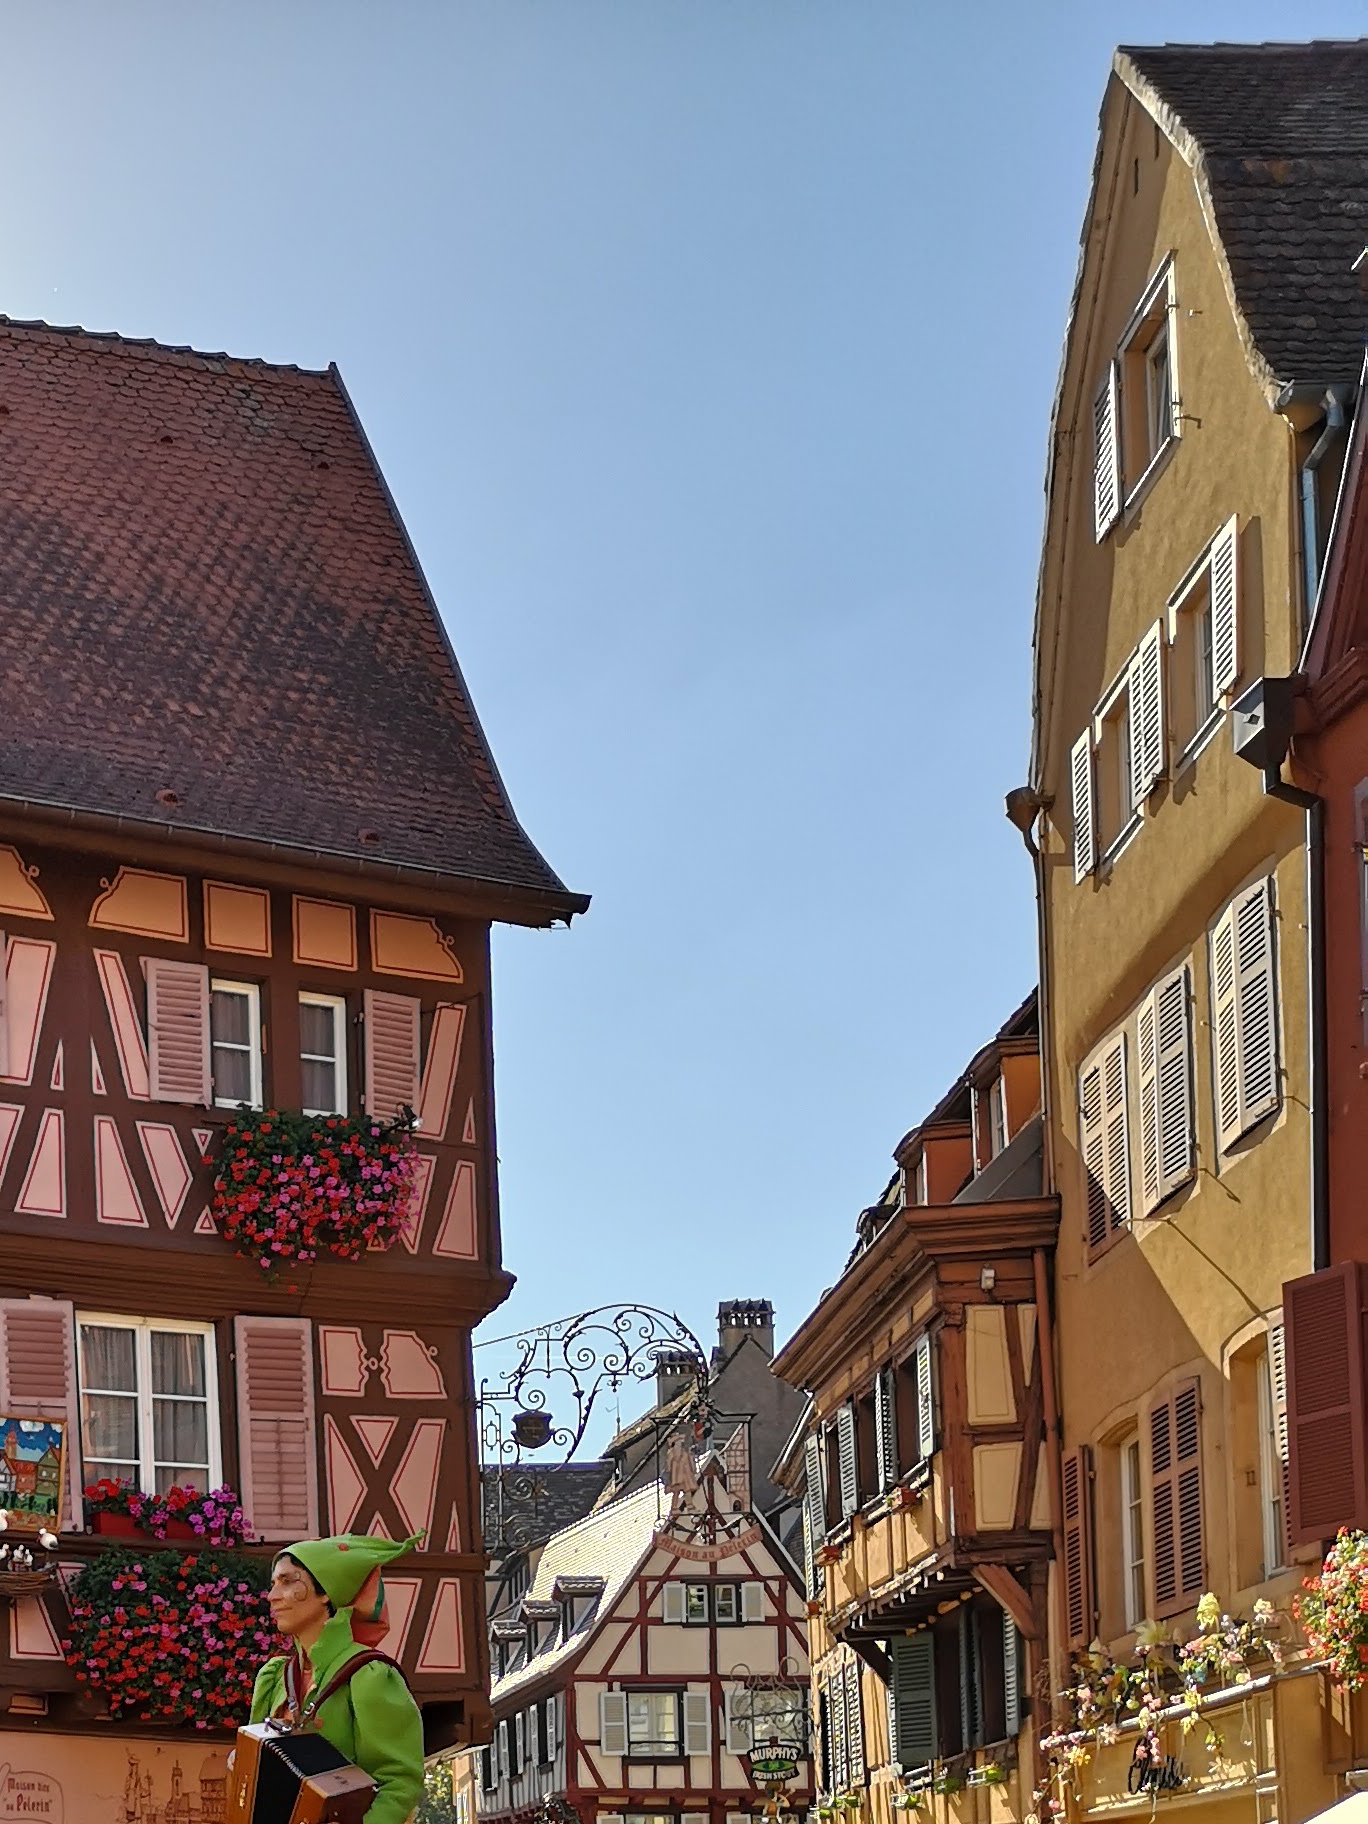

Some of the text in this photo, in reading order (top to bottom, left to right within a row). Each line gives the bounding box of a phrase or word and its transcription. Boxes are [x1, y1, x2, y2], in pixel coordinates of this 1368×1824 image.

[658, 1537, 699, 1560] Maison
[702, 1550, 715, 1559] au
[8, 1778, 35, 1792] Maison
